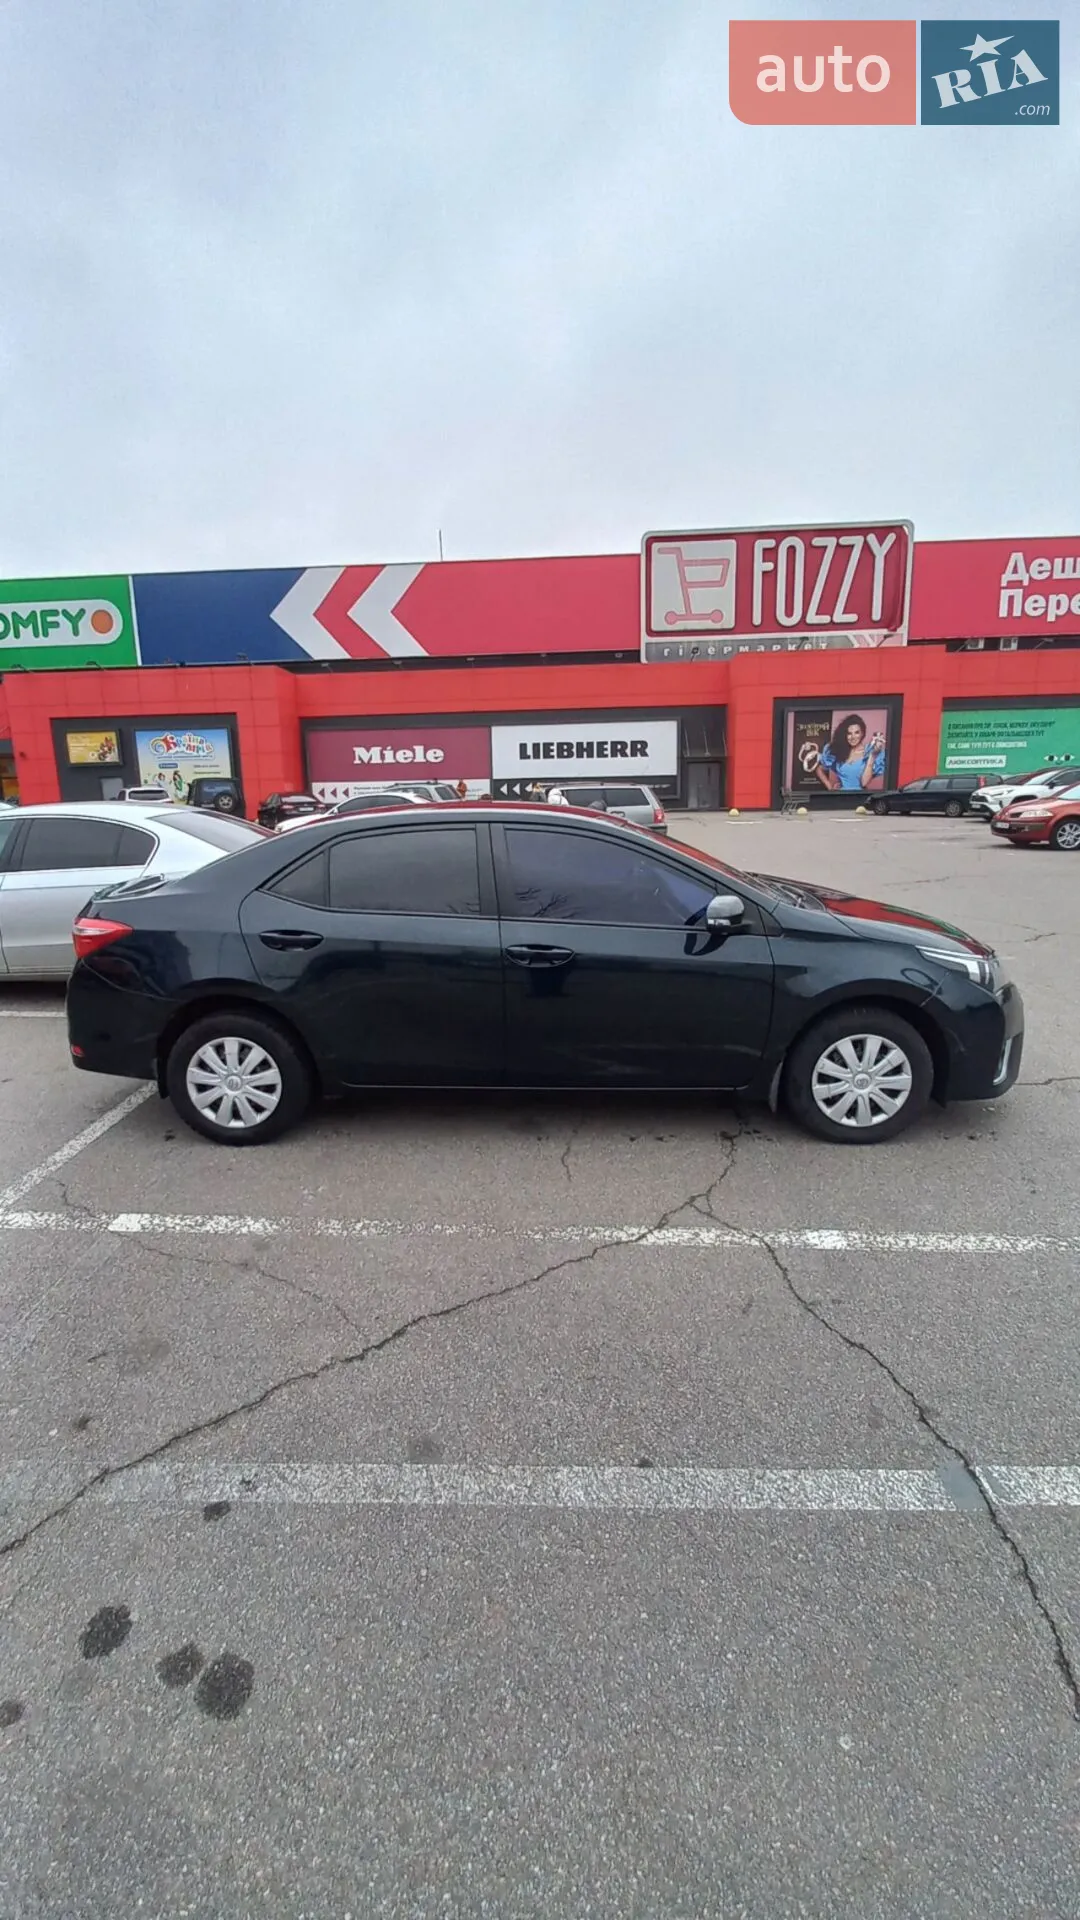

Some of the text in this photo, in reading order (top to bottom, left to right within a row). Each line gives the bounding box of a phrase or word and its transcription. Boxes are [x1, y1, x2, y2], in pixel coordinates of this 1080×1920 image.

[752, 532, 897, 626] FOZZY
[1001, 552, 1080, 587] Деш
[663, 643, 828, 657] гіермаркет
[352, 745, 444, 764] Miele
[518, 740, 649, 760] LIEBHERR
